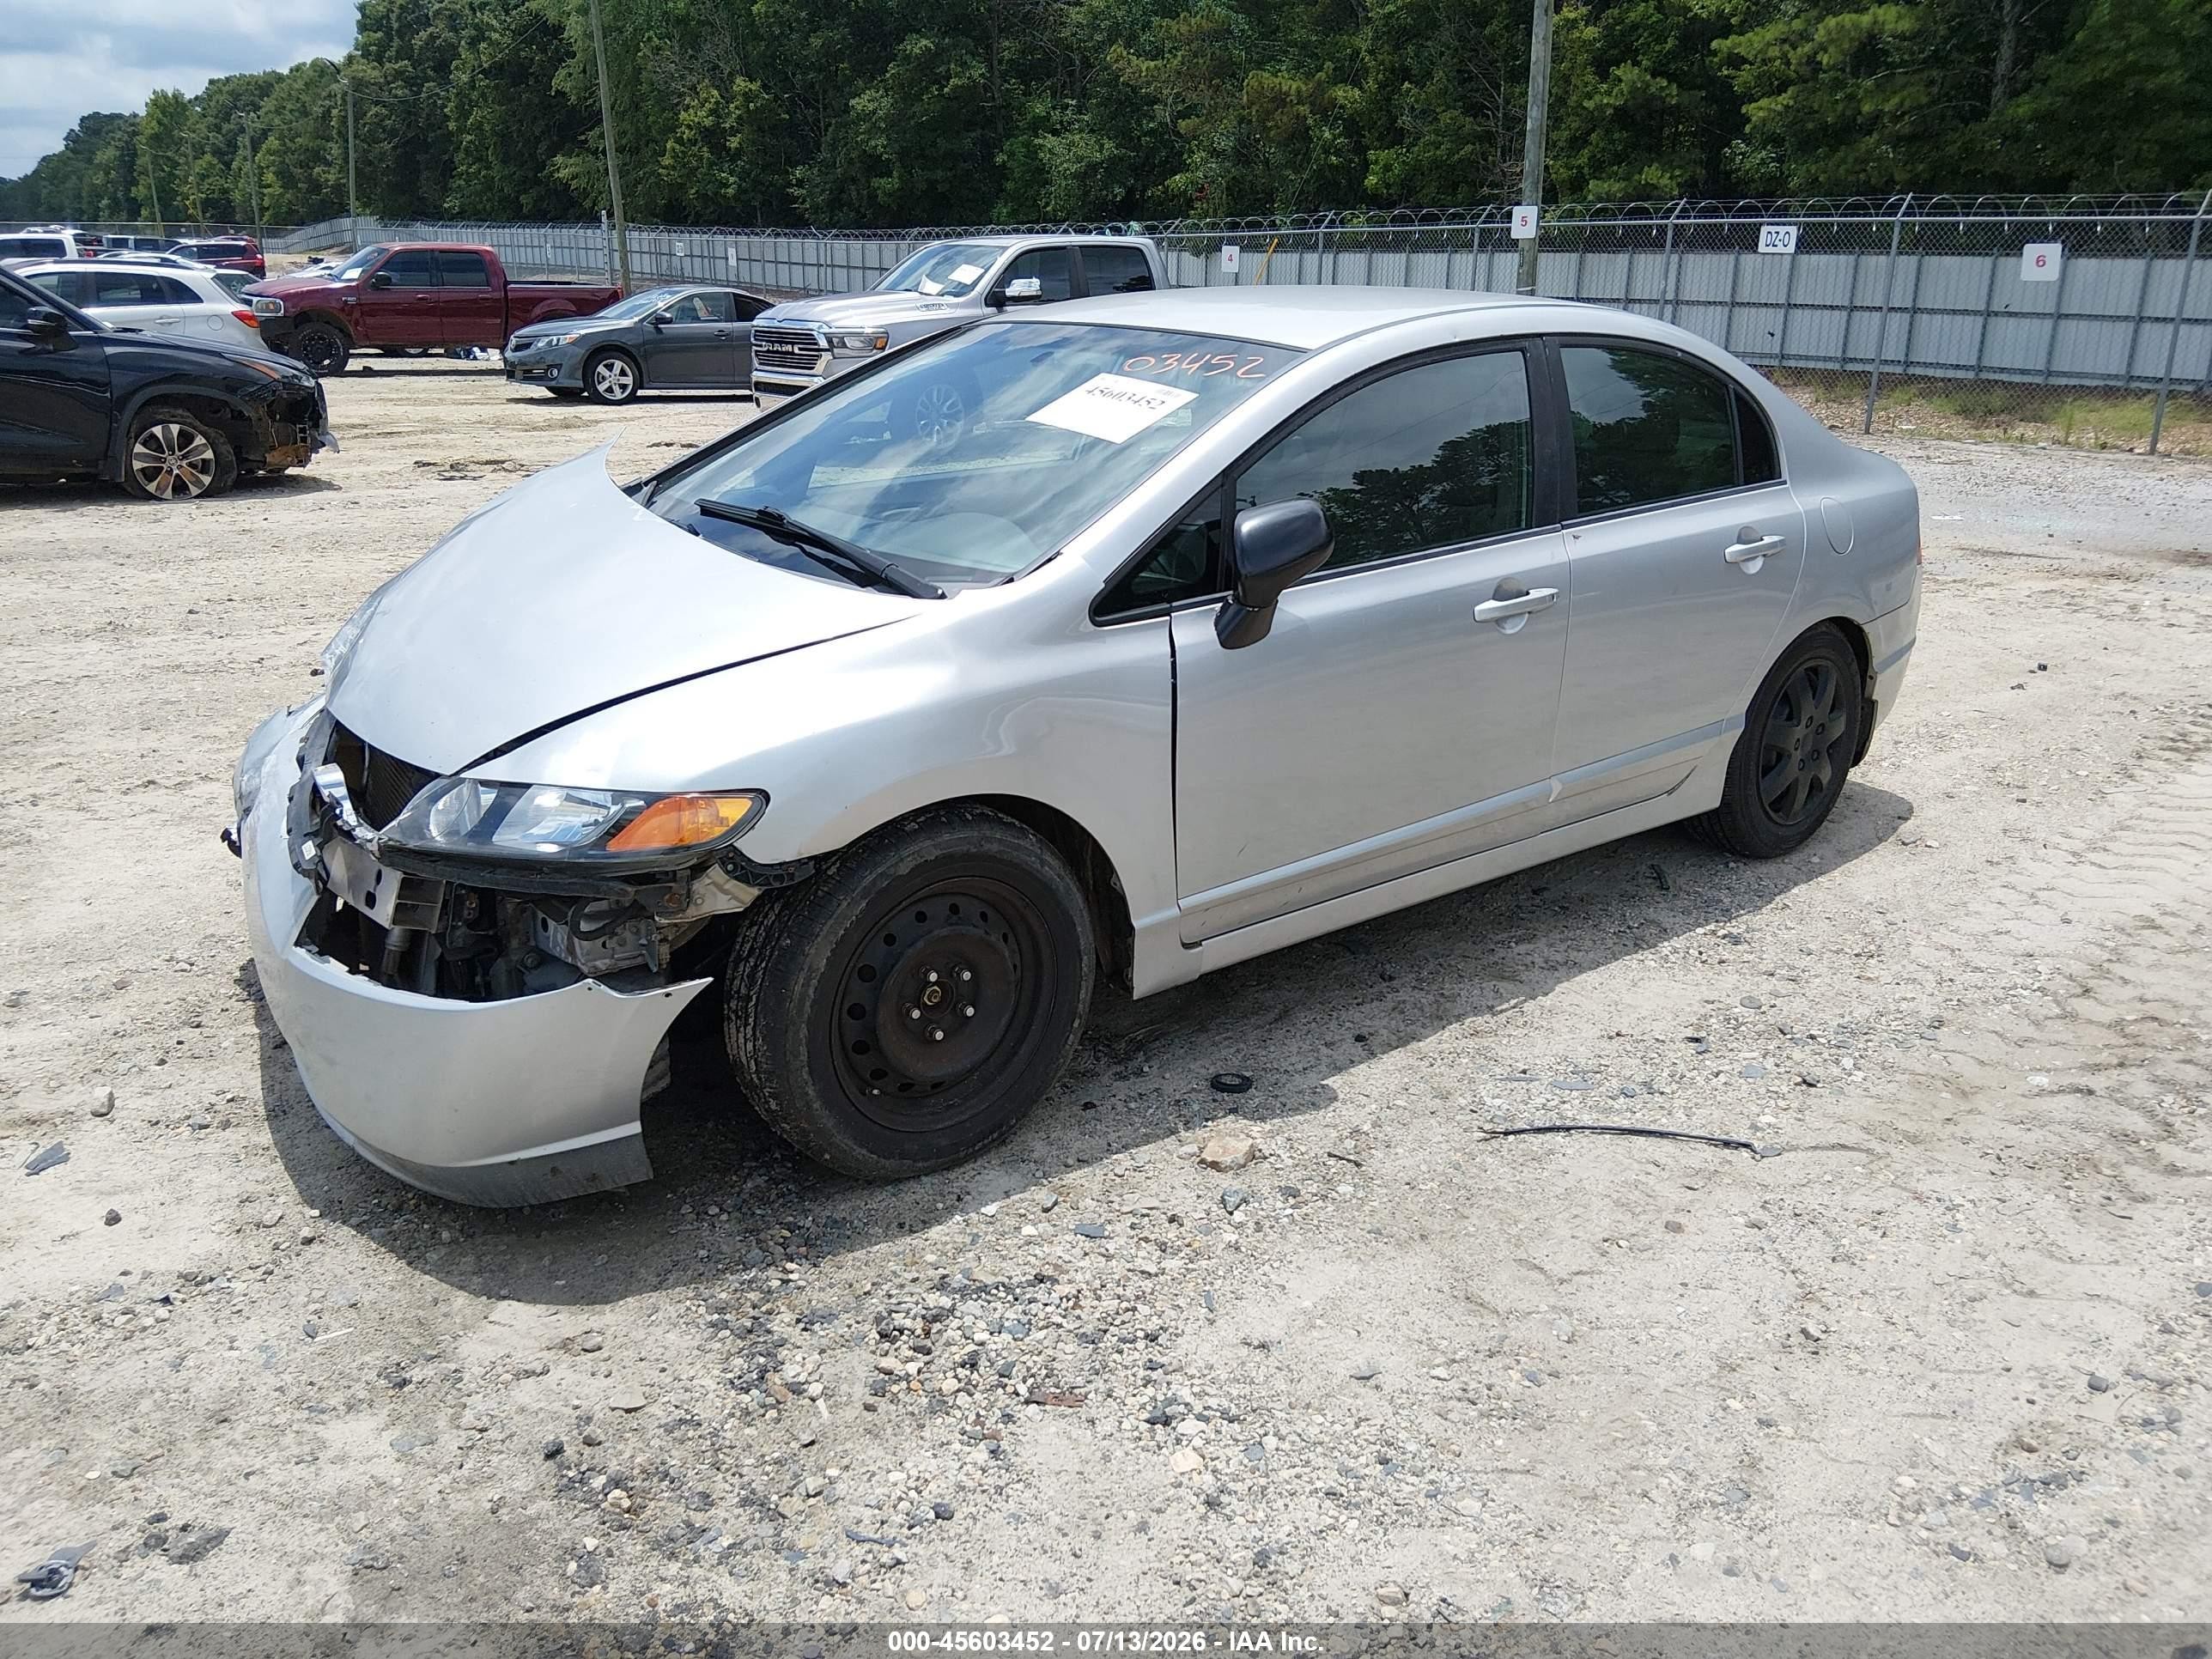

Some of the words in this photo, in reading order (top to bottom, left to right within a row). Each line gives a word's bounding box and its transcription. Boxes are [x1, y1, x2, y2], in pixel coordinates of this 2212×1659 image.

[1520, 216, 1528, 228] 5
[1227, 253, 1234, 263] 4
[2036, 254, 2047, 268] 6
[765, 342, 793, 352] RAM
[1123, 352, 1267, 379] 03452
[1085, 386, 1165, 410] 45603452
